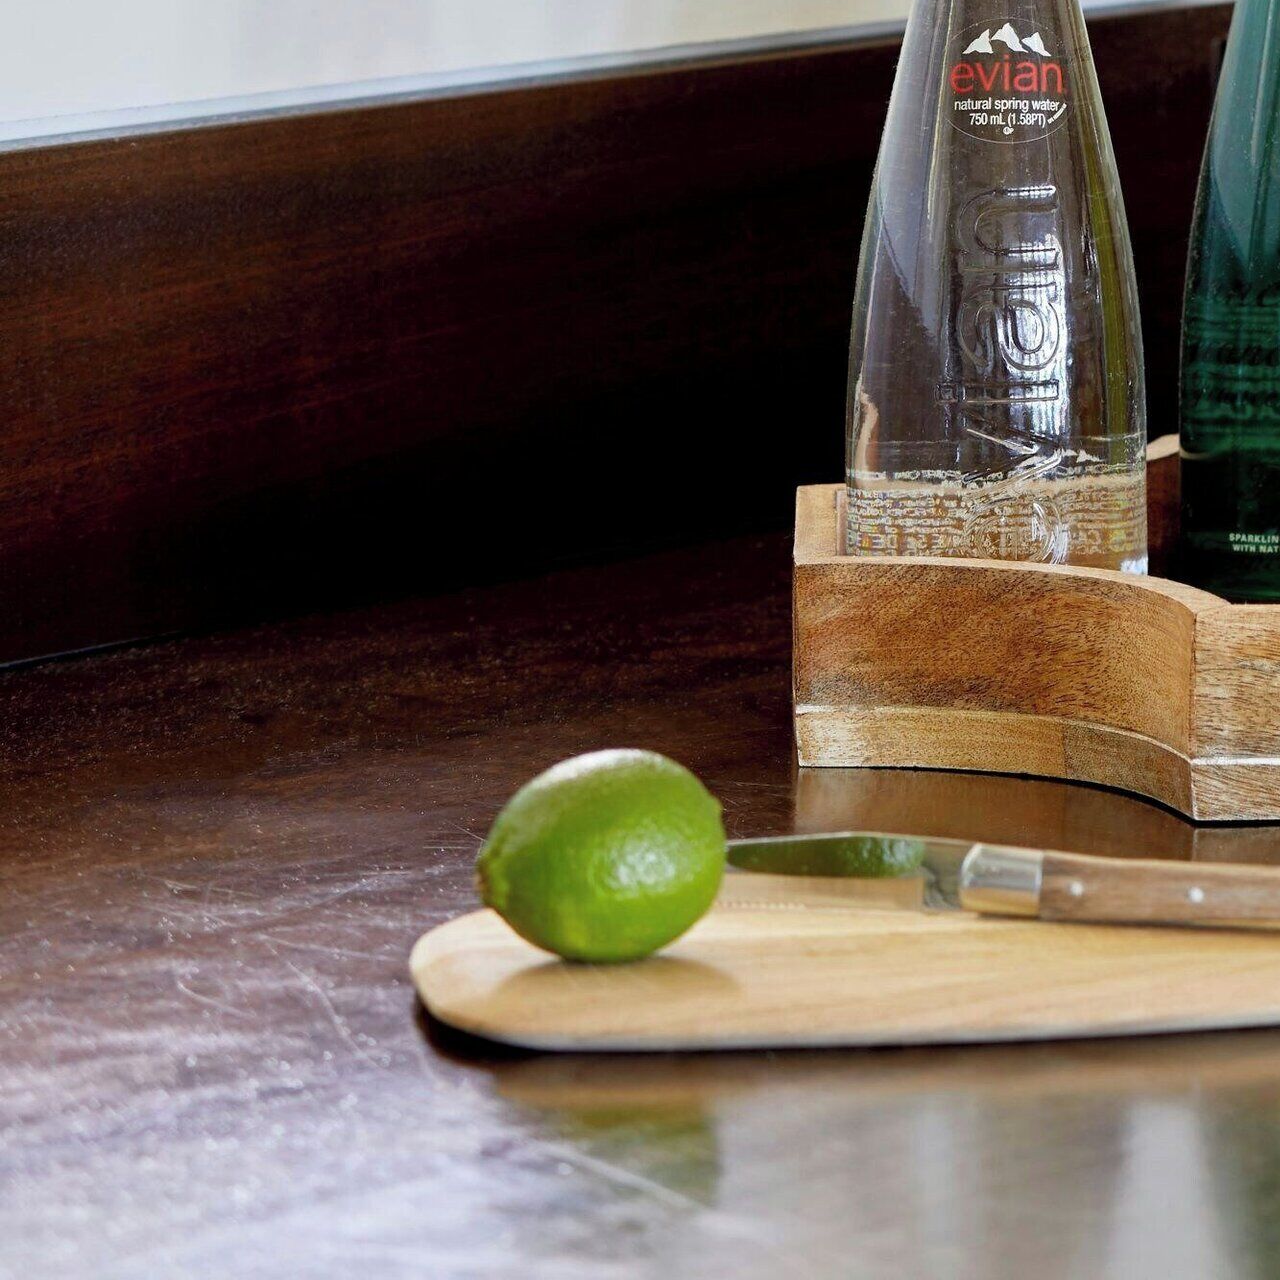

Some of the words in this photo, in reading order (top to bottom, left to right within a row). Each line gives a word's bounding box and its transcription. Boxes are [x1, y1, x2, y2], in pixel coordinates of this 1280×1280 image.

[949, 53, 1064, 94] evian
[954, 97, 992, 111] natural
[994, 97, 1029, 113] spring
[1031, 98, 1060, 111] water
[969, 113, 988, 125] 750
[990, 113, 1006, 125] mL
[1007, 113, 1046, 128] (1.58PT)
[1232, 544, 1256, 552] WITH
